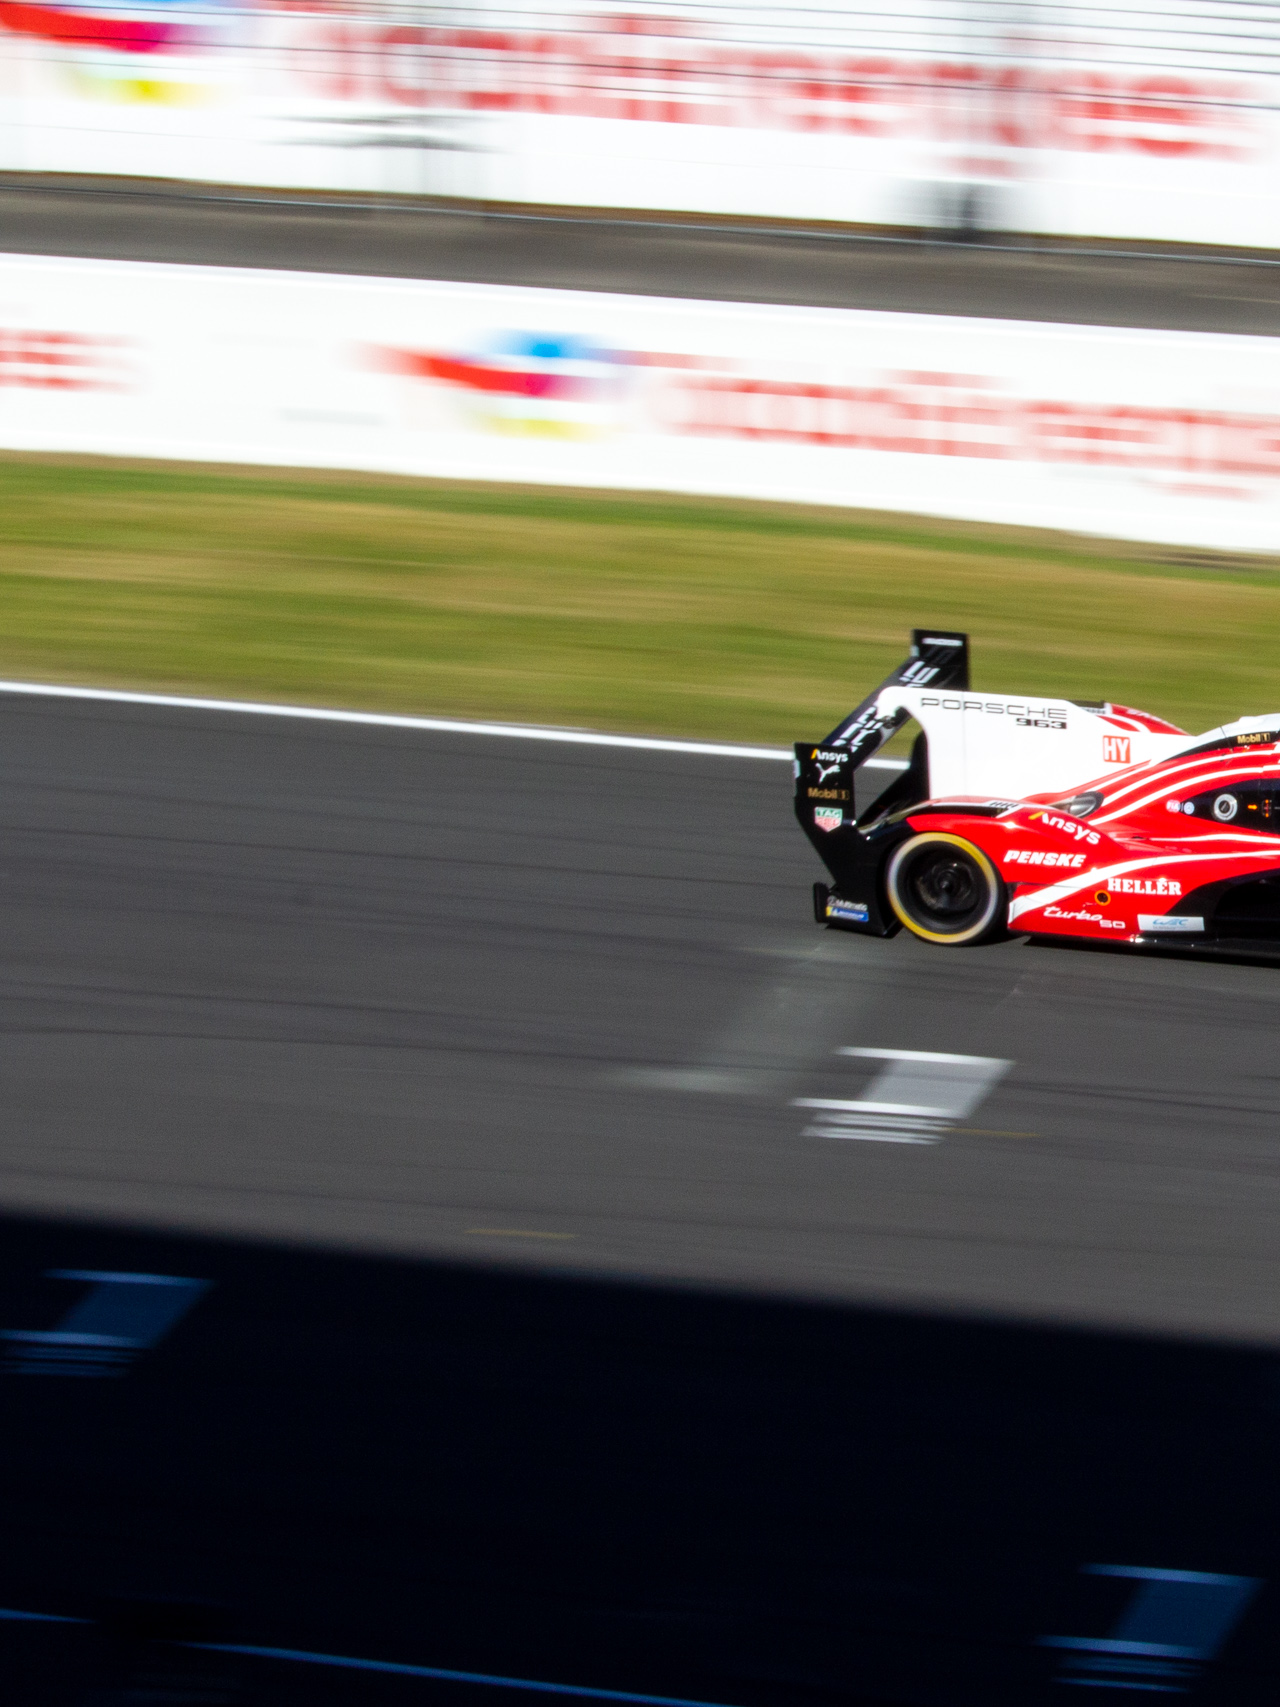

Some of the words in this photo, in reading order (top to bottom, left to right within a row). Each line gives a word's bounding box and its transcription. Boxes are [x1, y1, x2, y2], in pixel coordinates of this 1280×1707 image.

[921, 698, 1067, 719] PORSCHE
[1016, 717, 1067, 729] 963
[1237, 733, 1260, 744] Mobil
[811, 748, 848, 763] Ansys
[1103, 736, 1130, 763] HY
[808, 787, 838, 799] Mobil
[1028, 811, 1101, 845] Ansys
[1003, 850, 1087, 868] PENSKE
[1107, 878, 1182, 895] HELLER
